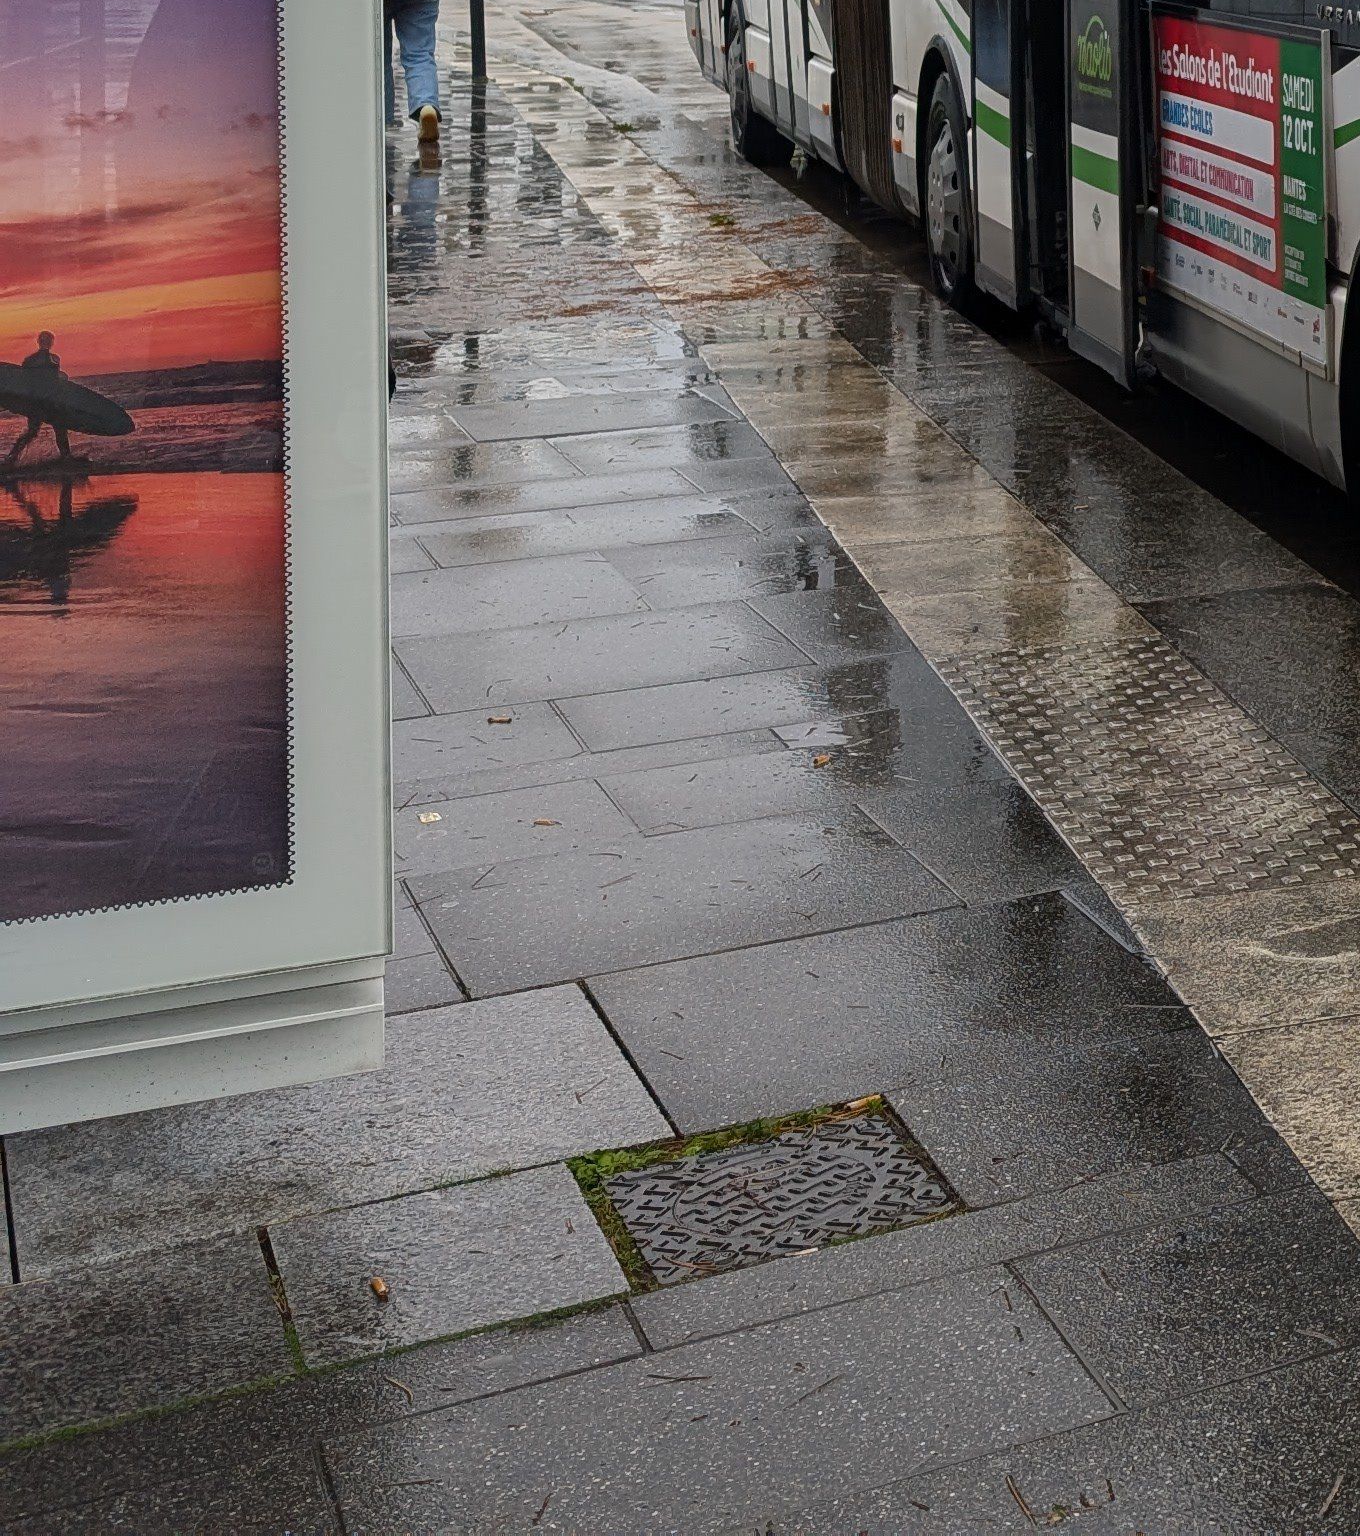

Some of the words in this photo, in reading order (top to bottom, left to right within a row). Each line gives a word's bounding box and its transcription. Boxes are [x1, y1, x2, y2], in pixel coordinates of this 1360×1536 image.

[1173, 43, 1206, 85] Salons
[1208, 48, 1221, 89] de
[1282, 72, 1315, 114] SAMEDI
[1162, 98, 1189, 129] GRANDES
[1190, 100, 1214, 137] ÉCOLES
[1282, 114, 1293, 149] 12
[1294, 115, 1317, 156] OCT.
[1208, 163, 1255, 203] COMMUNICATION
[1252, 231, 1272, 262] SPORT
